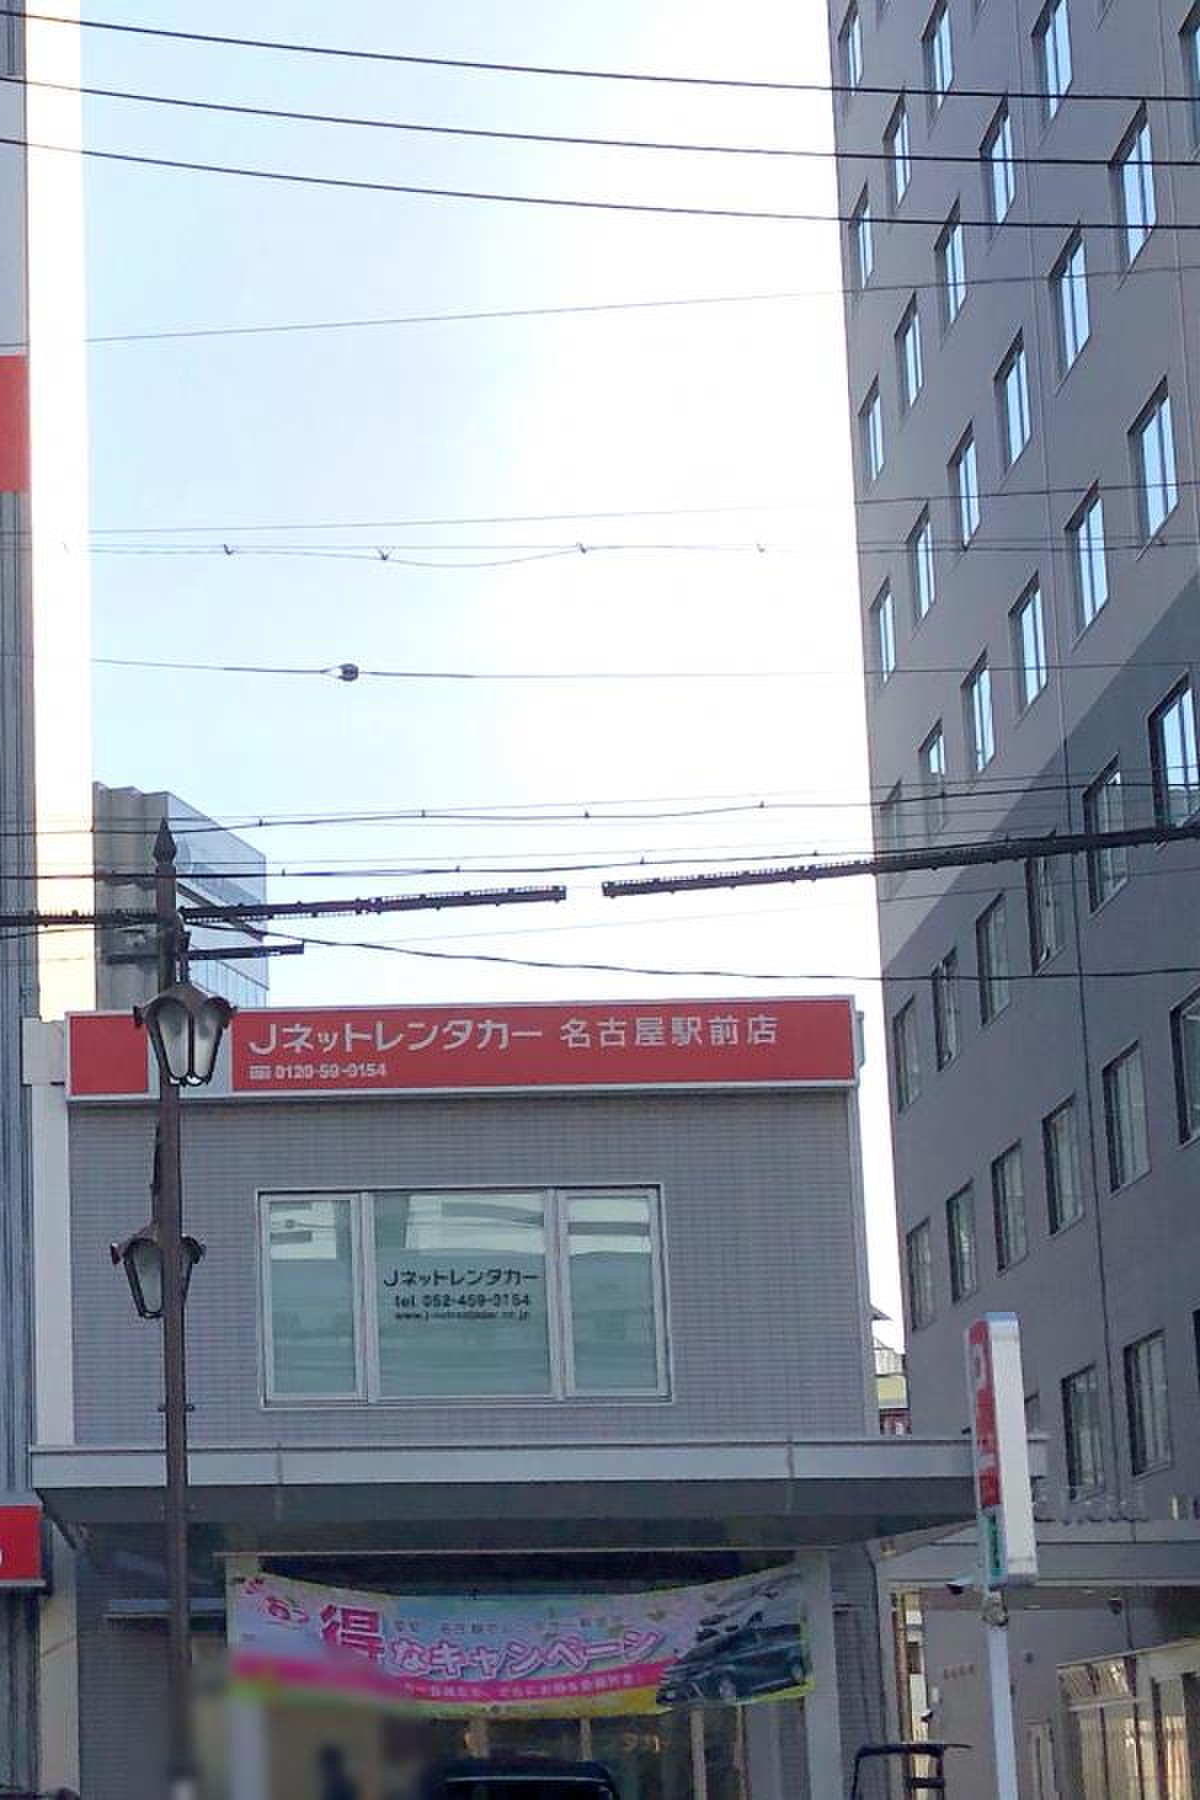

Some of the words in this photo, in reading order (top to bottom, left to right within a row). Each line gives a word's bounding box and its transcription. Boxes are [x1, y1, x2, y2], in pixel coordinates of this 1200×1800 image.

[248, 1019, 544, 1055] Jネットレンタカー
[560, 1014, 779, 1048] 名古屋駅前店
[383, 1269, 539, 1287] Jネットレンタカー
